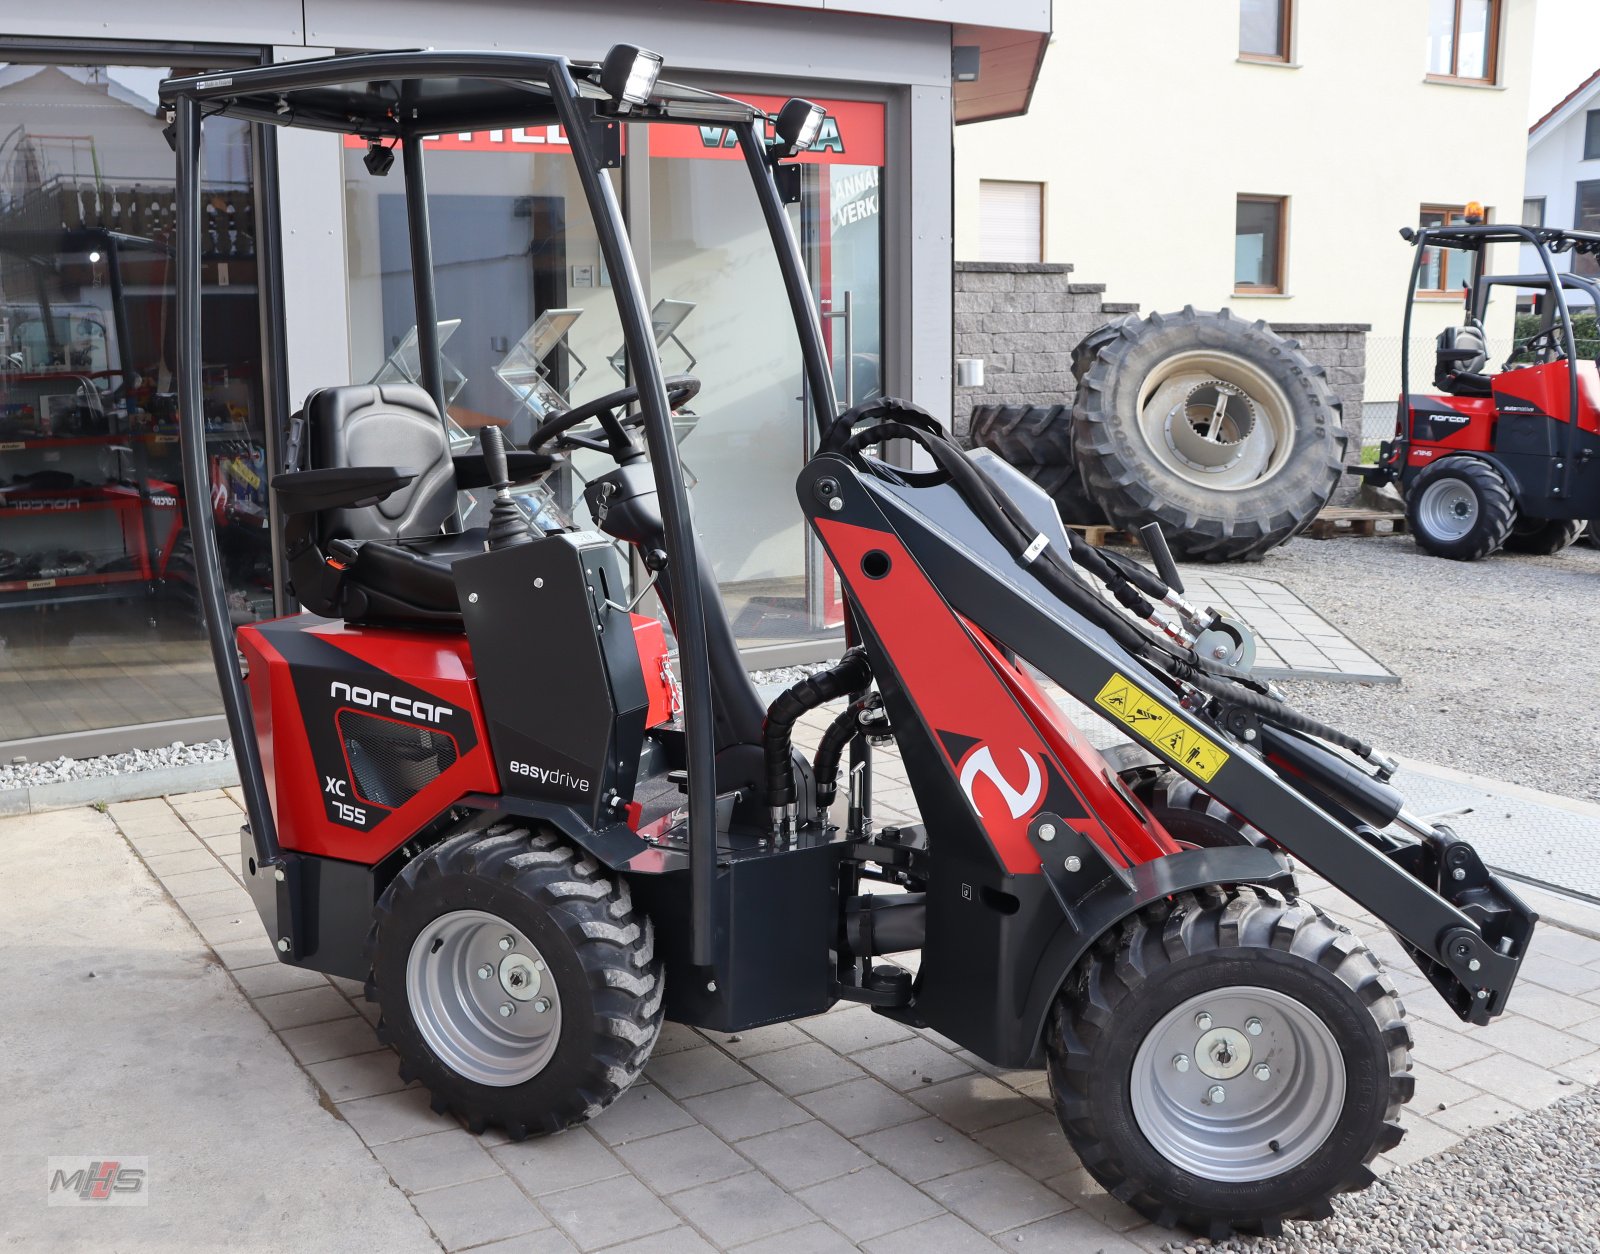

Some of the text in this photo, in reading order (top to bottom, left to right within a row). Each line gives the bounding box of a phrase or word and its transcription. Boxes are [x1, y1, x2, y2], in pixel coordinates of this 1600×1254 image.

[698, 113, 845, 154] VLA
[1429, 414, 1470, 423] norcar
[330, 681, 453, 723] norcar
[325, 775, 346, 797] XC
[509, 760, 590, 792] easydrive
[331, 800, 367, 826] 755
